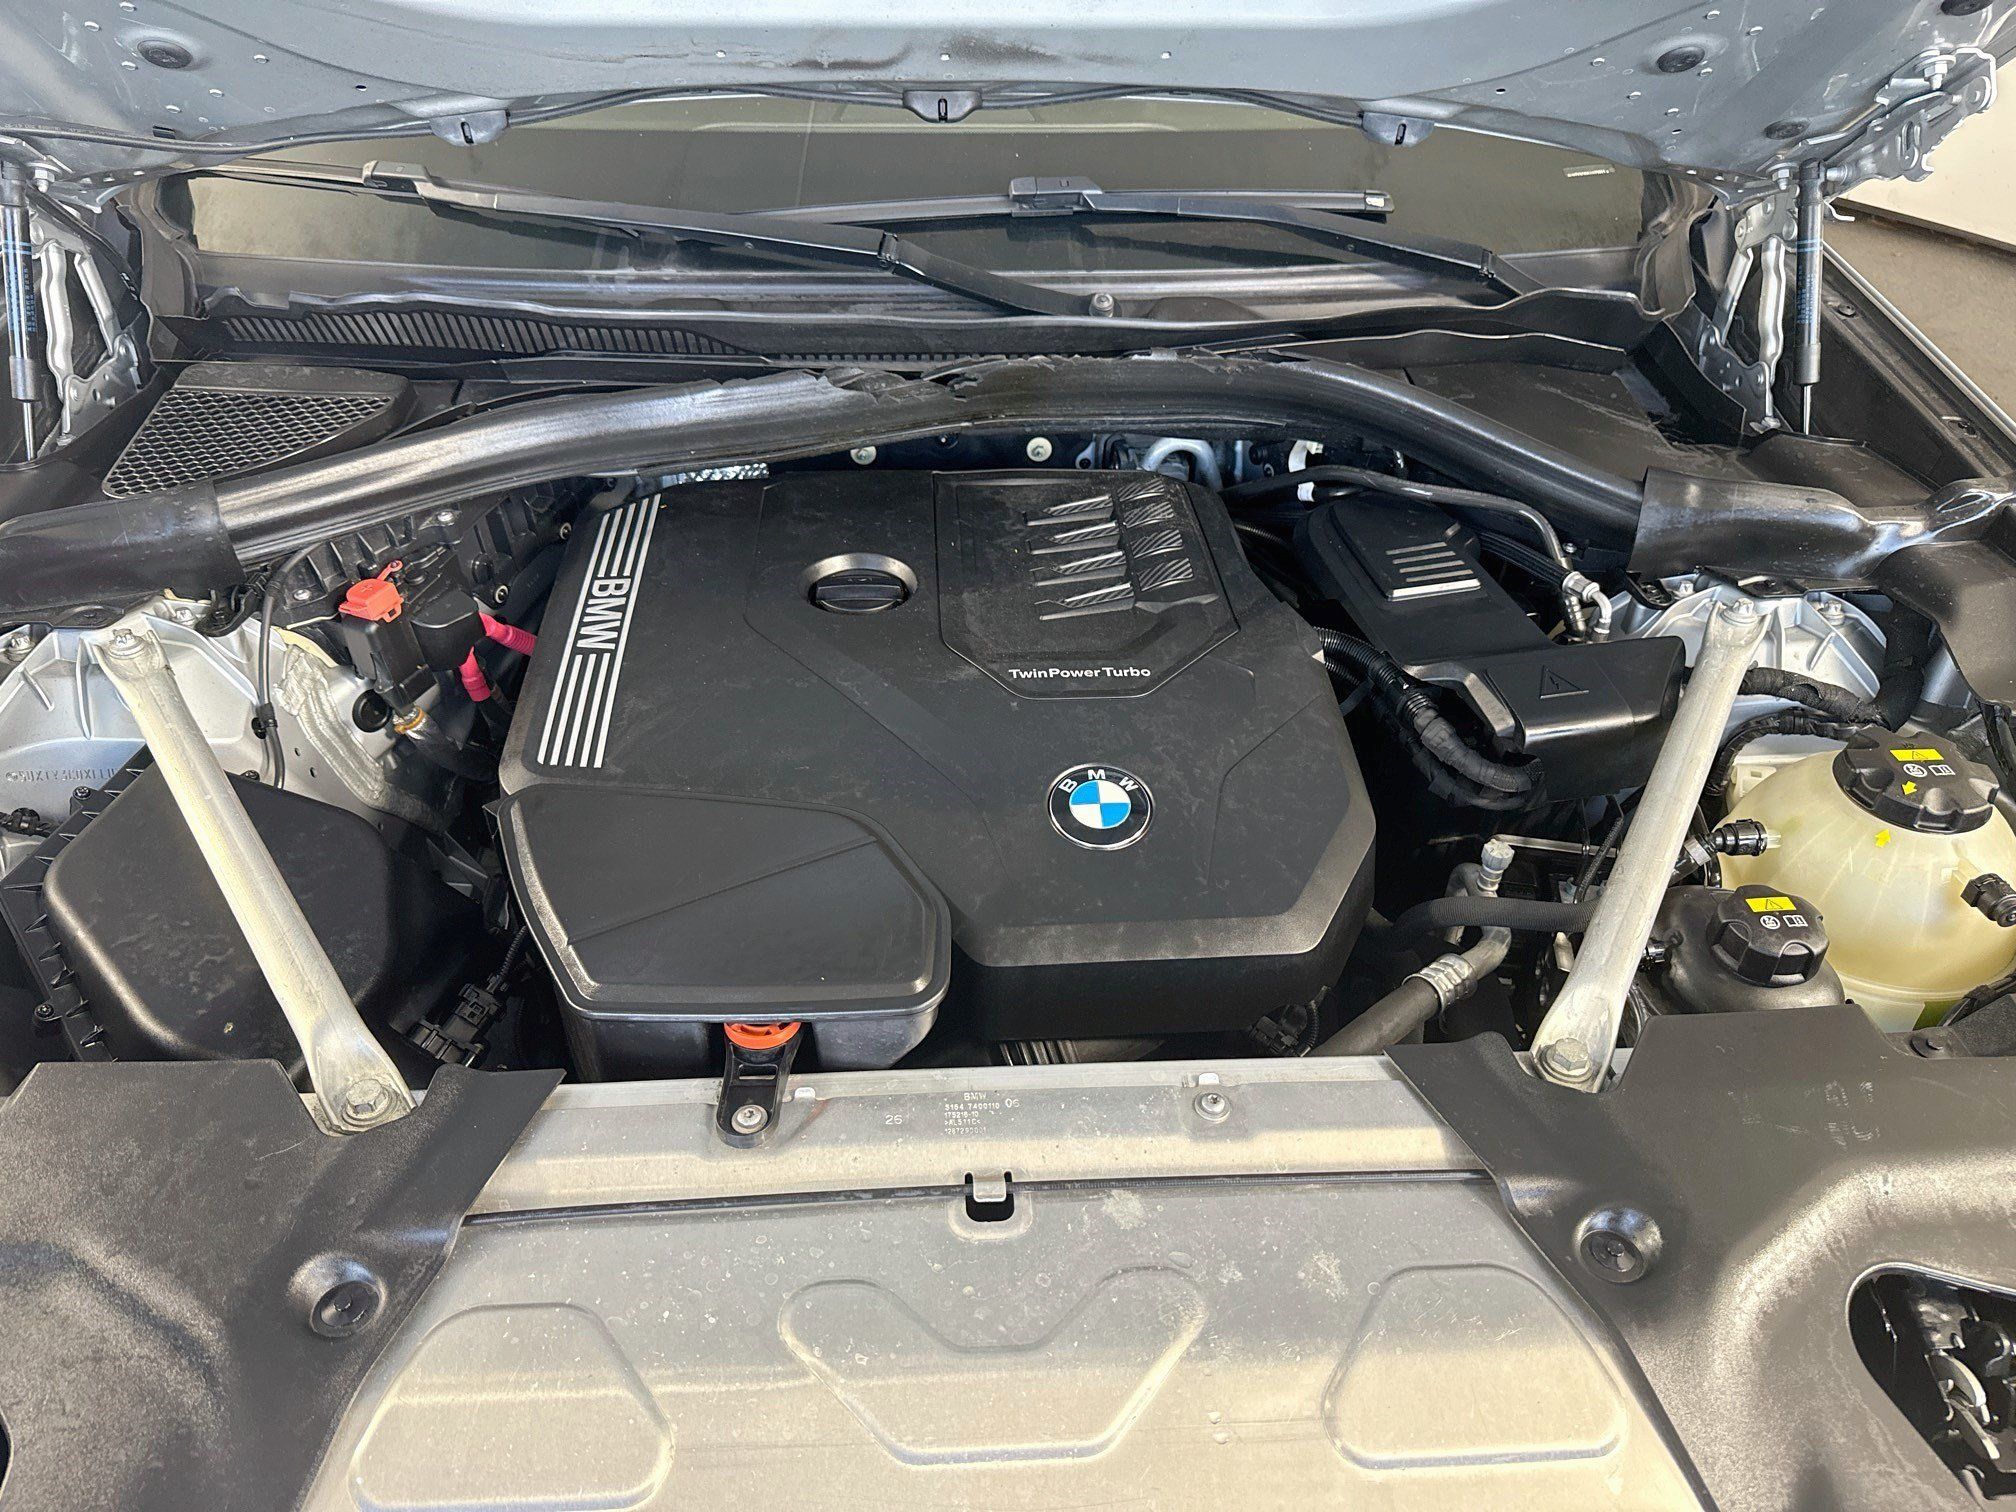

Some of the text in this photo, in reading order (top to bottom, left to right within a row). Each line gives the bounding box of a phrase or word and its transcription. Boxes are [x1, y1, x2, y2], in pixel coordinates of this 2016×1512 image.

[576, 578, 631, 650] BMW
[1102, 666, 1151, 678] Turbo
[1058, 768, 1138, 794] BMW
